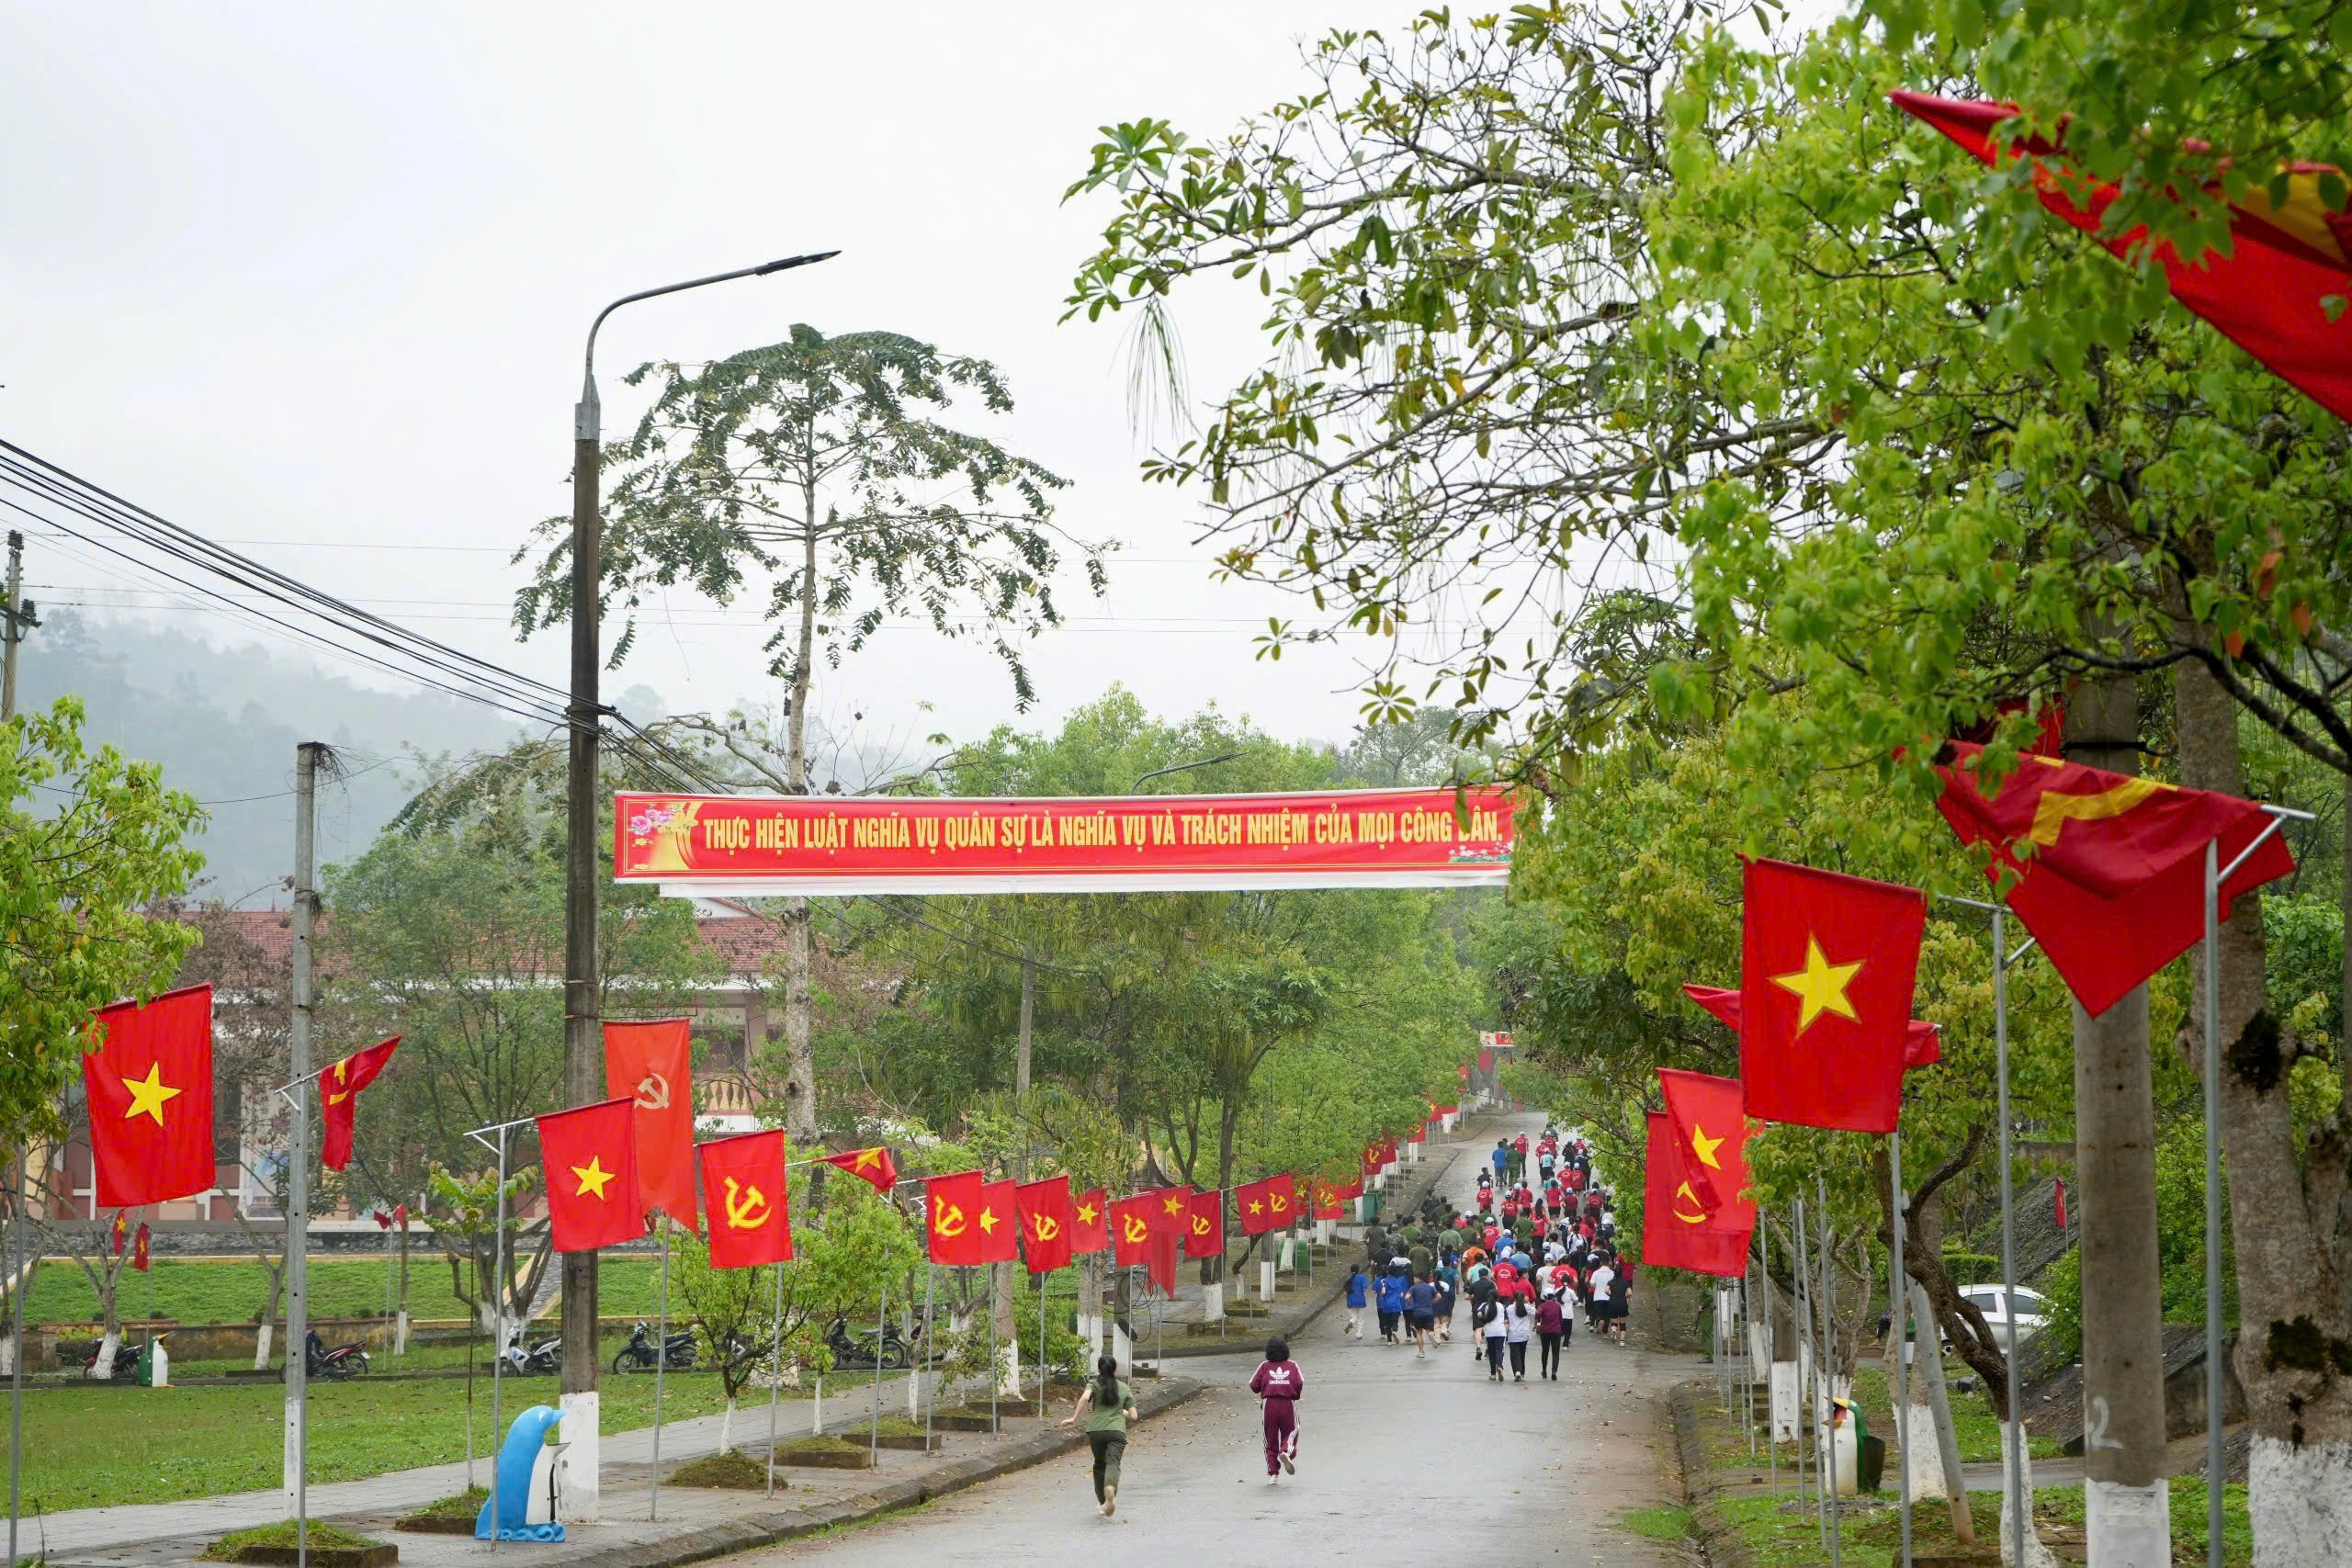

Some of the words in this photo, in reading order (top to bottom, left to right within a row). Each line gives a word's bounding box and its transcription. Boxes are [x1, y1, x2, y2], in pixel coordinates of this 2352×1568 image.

[704, 816, 750, 855] THỰC
[755, 812, 797, 855] HIỆN
[804, 812, 848, 854] LUẬT
[854, 812, 910, 848] NGHĨA
[915, 817, 939, 854] VỤ
[944, 811, 995, 851] QUÂN
[1001, 813, 1028, 853] SỰ
[1031, 809, 1054, 846] LÀ
[1059, 809, 1117, 846] NGHĨA
[1122, 815, 1147, 852] VỤ
[1151, 809, 1176, 845] VÀ
[1181, 808, 1241, 845] TRÁCH
[1247, 807, 1309, 852] NHIỆM
[1315, 803, 1352, 844] CỦA
[1358, 812, 1395, 850] MỌI
[1401, 806, 1453, 842] CÔNG
[2091, 1395, 2123, 1450] 2
